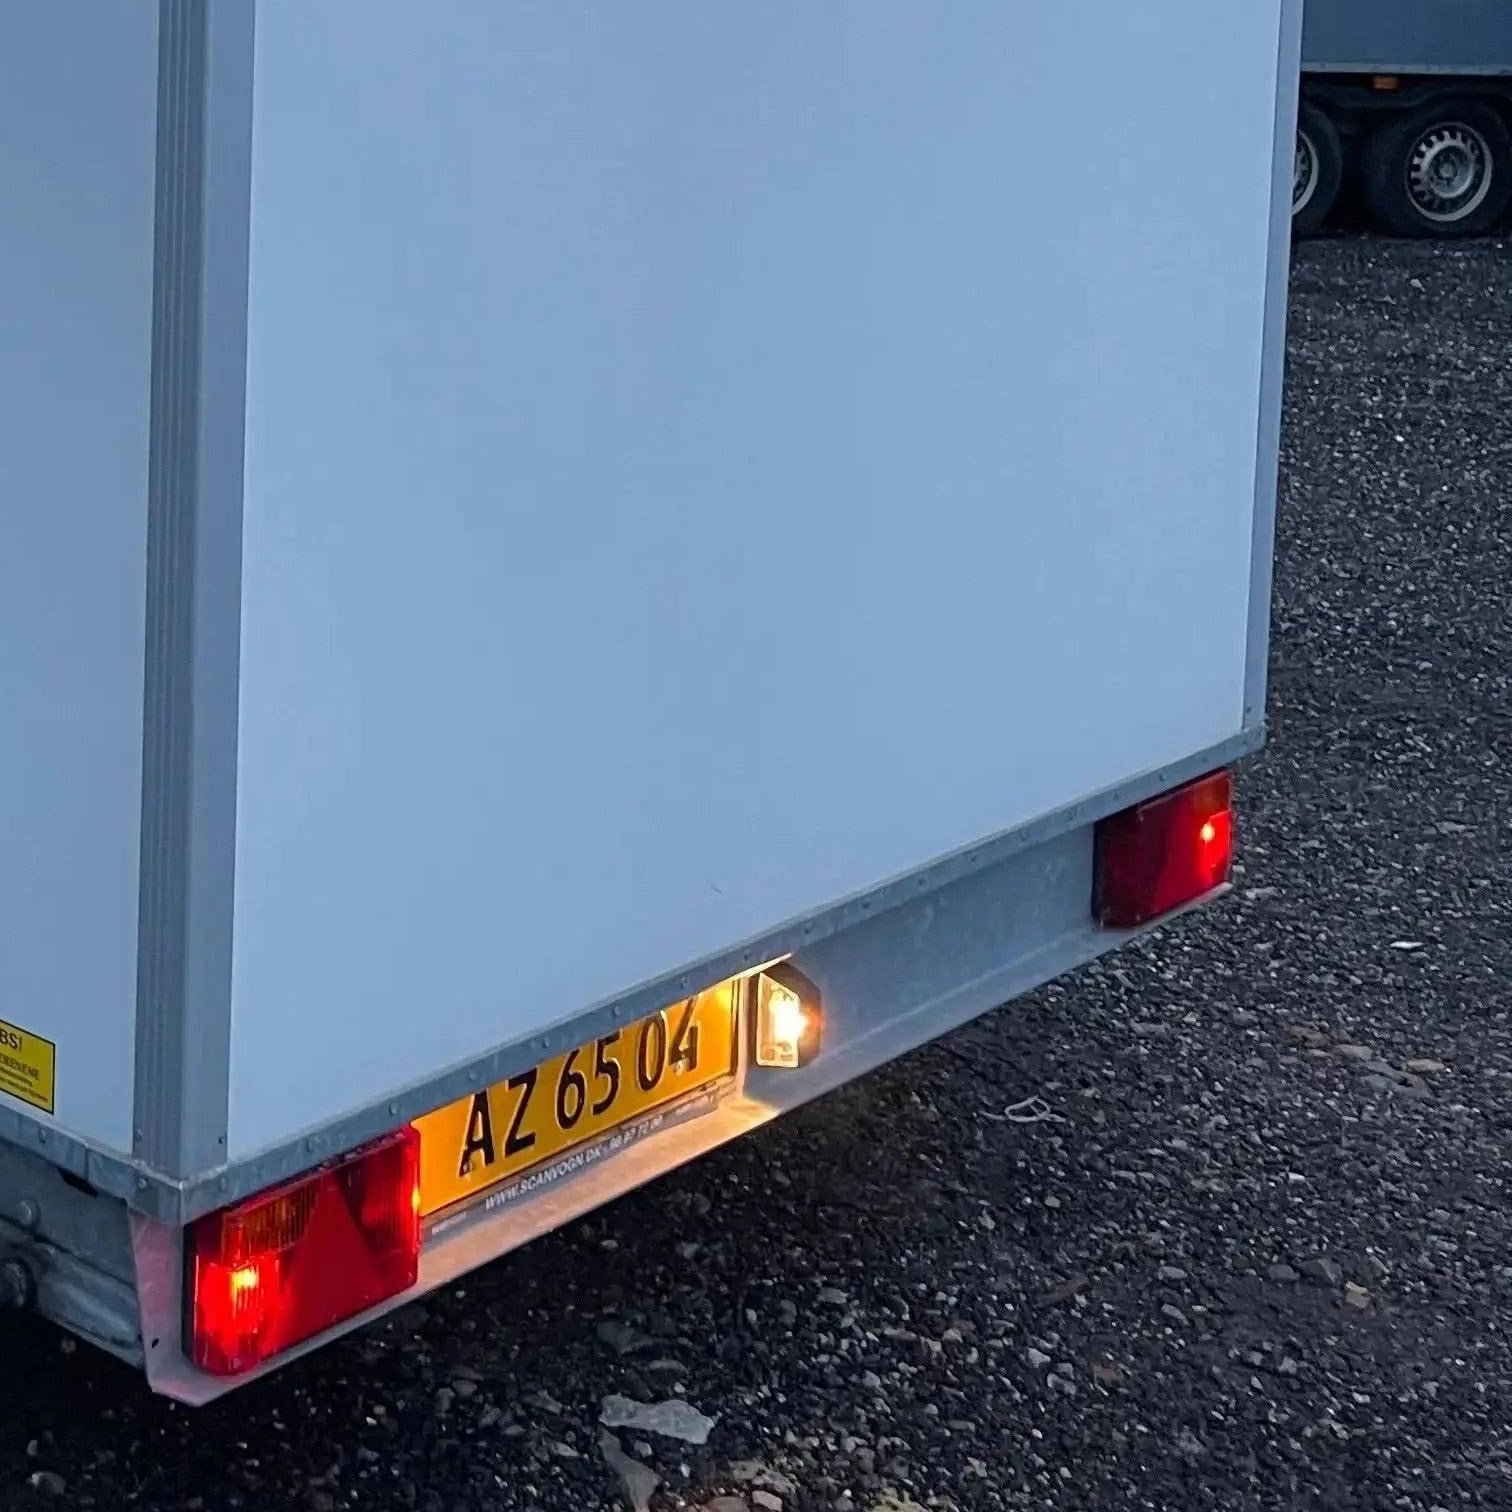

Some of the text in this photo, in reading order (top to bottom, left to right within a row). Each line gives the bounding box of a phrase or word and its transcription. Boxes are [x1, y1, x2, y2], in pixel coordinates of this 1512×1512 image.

[459, 998, 698, 1177] AZ 65 04
